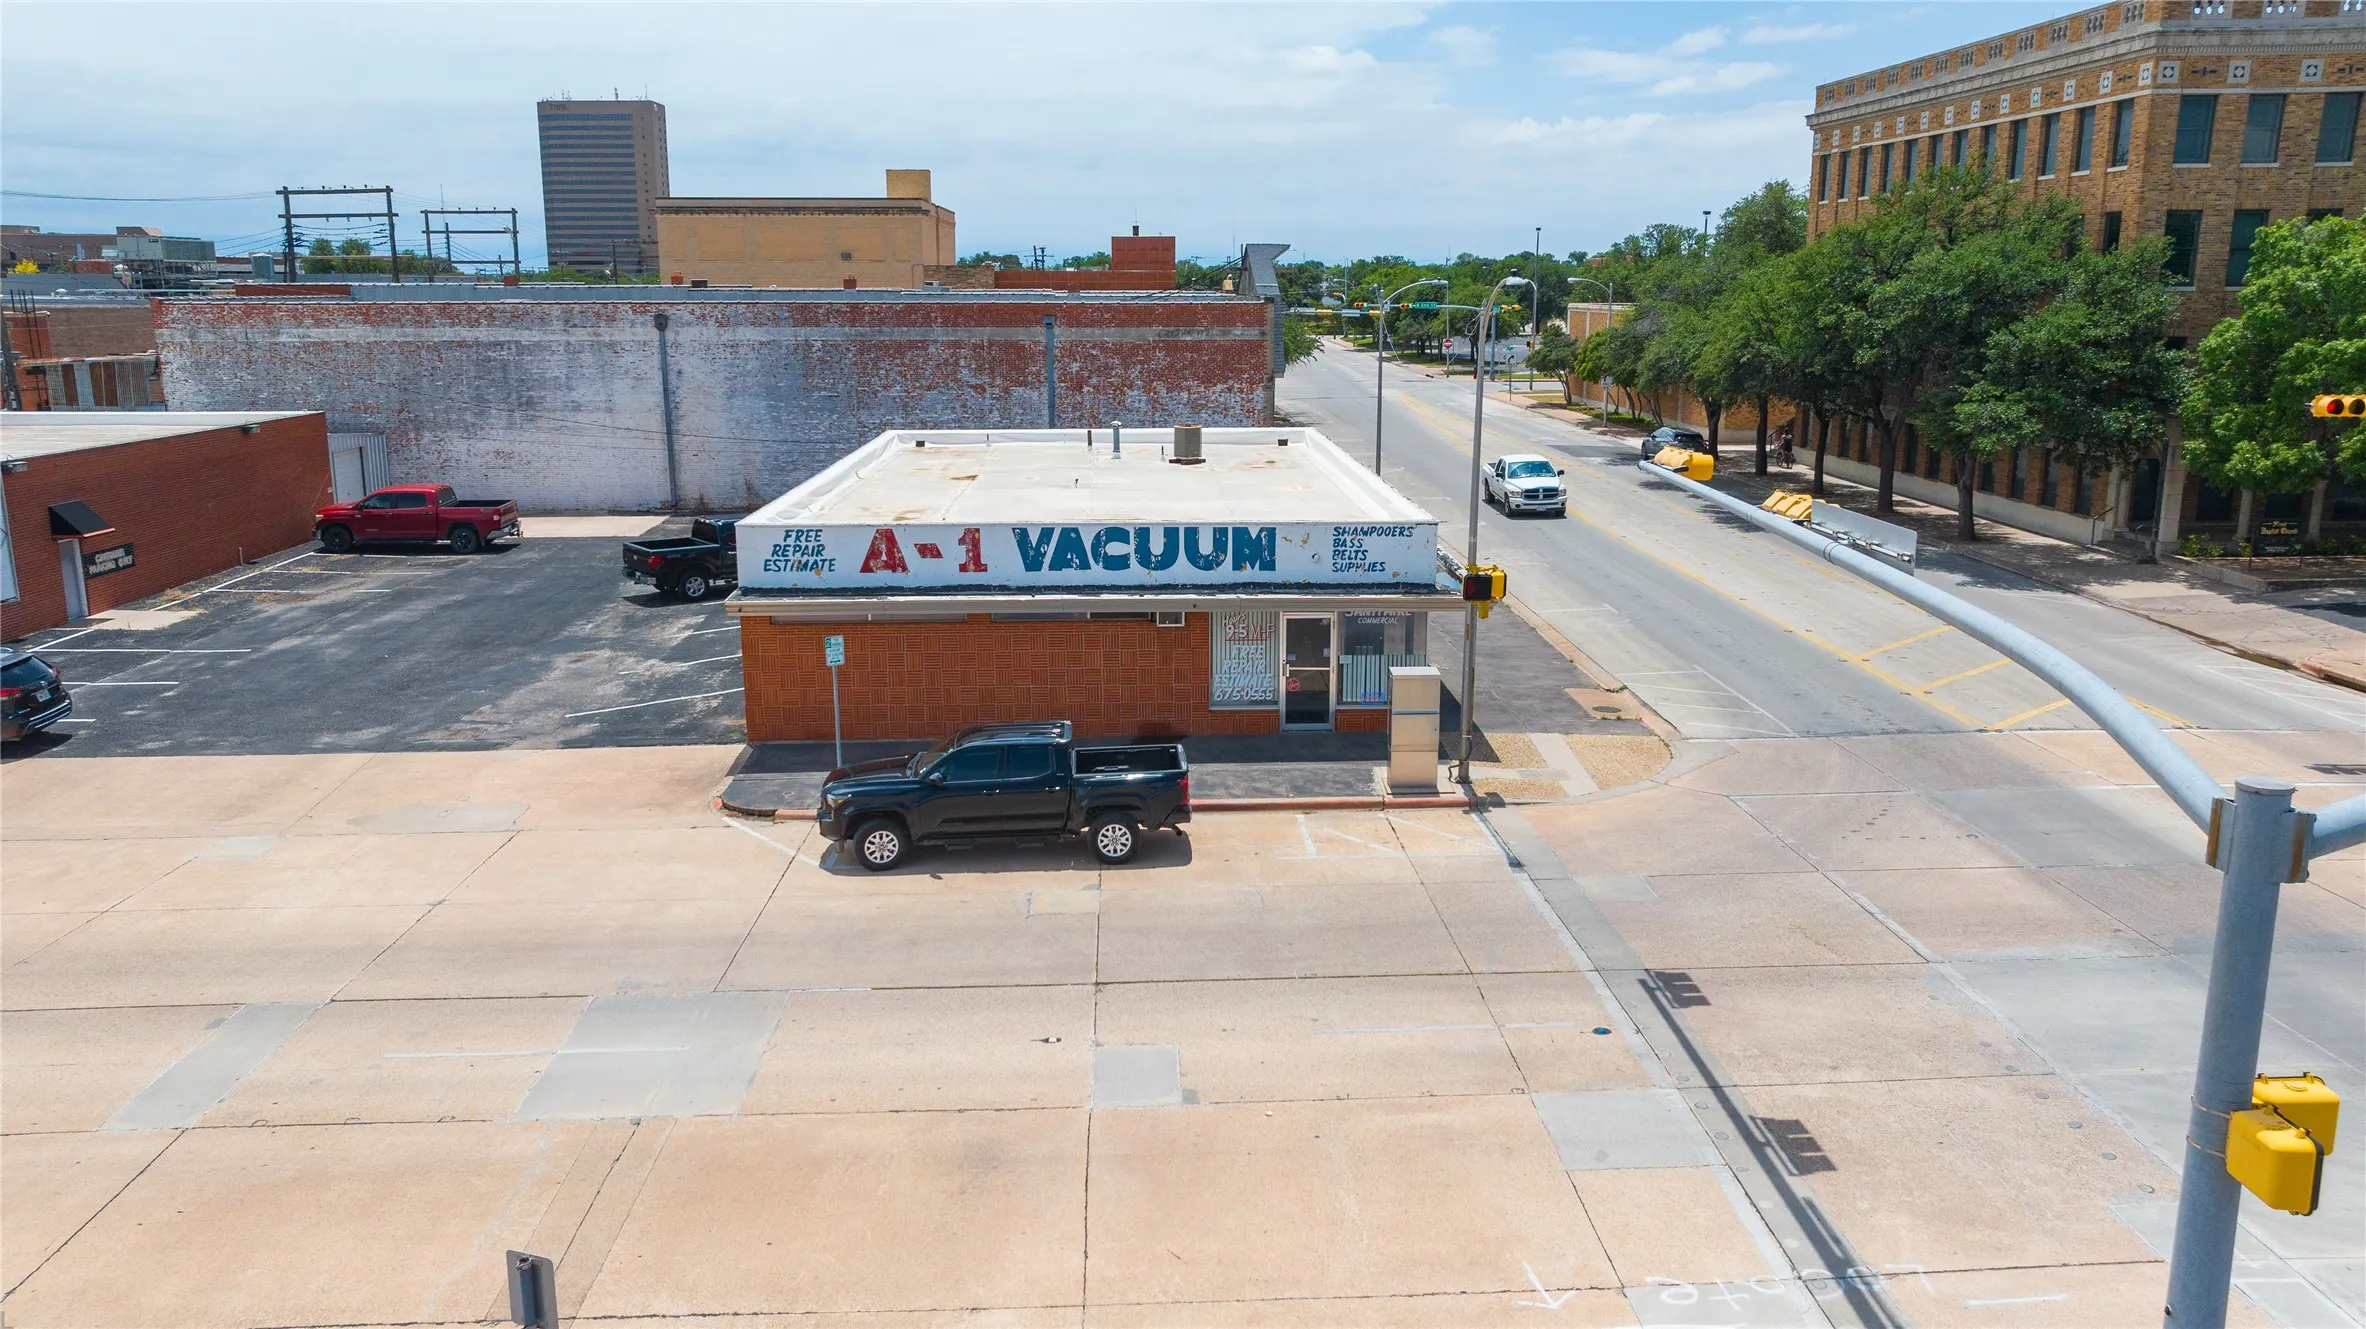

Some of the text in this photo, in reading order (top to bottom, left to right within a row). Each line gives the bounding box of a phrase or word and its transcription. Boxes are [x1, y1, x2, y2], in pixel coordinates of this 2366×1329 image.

[783, 529, 823, 543] FREE
[1332, 525, 1414, 538] SHAMPOOERS
[771, 543, 825, 558] REPAIR
[859, 526, 1277, 572] A-1 VACUUM
[1332, 538, 1364, 549] BASS
[1331, 549, 1367, 561] BELTS
[763, 558, 836, 573] ESTIMATE
[1331, 561, 1386, 573] SUPPLIES
[1222, 613, 1247, 627] Hours
[1226, 624, 1275, 639] 9-5 M-F
[1232, 645, 1265, 660] FREE
[1221, 660, 1266, 674] REPAIR
[1214, 674, 1273, 688] ESTIMATE
